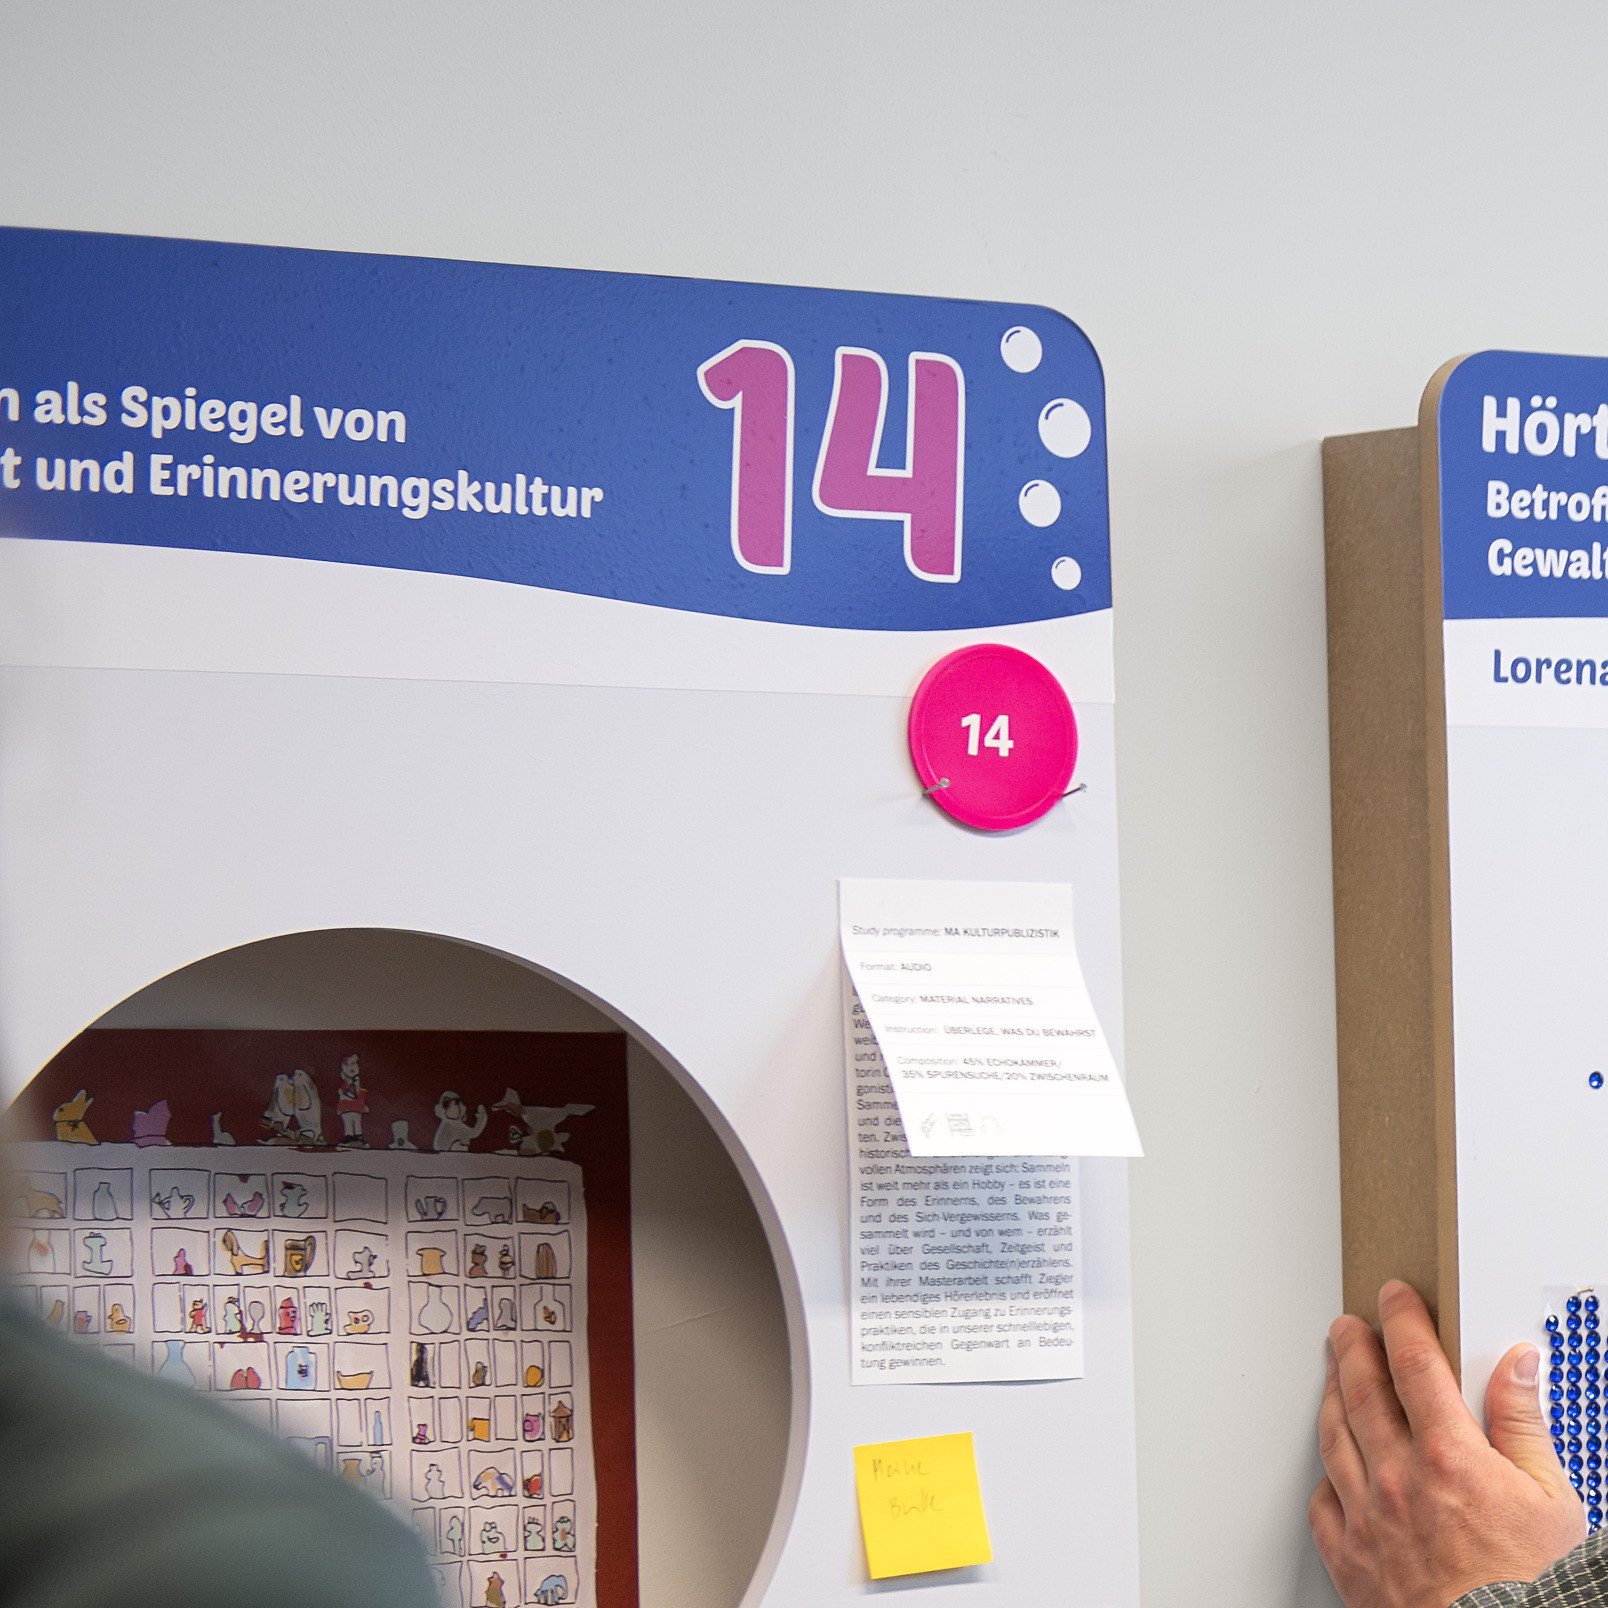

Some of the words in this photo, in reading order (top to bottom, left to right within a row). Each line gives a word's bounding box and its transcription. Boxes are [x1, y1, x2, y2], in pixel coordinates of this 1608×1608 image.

[34, 381, 107, 426] als
[119, 385, 304, 444] Spiegel
[314, 405, 406, 444] von
[697, 339, 966, 583] 14
[35, 451, 134, 495] und
[149, 452, 603, 520] Erinnerungskultur
[961, 713, 1014, 757] 14
[852, 925, 880, 937] Study
[882, 927, 942, 938] programme:
[944, 927, 960, 937] MA
[963, 928, 1060, 938] KULTURPUBLIZISTIK
[900, 963, 932, 972] AUDIO
[919, 995, 969, 1005] MATERIAL
[971, 996, 1034, 1006] NARRATIVES
[1001, 1026, 1025, 1036] WAS
[1026, 1027, 1041, 1037] DU
[859, 1164, 892, 1175] vollen
[894, 1163, 967, 1176] Atmosphären
[968, 1163, 994, 1176] zeigt
[1021, 1162, 1070, 1173] Sammeln
[902, 1180, 931, 1190] mehr
[933, 1179, 949, 1190] als
[952, 1179, 970, 1190] ein
[972, 1178, 1006, 1191] Hobby
[1018, 1180, 1031, 1189] es
[1033, 1178, 1046, 1189] ist
[1048, 1178, 1070, 1188] eine
[860, 1196, 888, 1207] Form
[896, 1196, 917, 1207] des
[987, 1195, 1007, 1206] des
[1014, 1194, 1071, 1206] Bewahrens
[860, 1212, 881, 1223] und
[889, 1212, 909, 1223] des
[1028, 1210, 1050, 1221] Was
[860, 1229, 909, 1240] sammelt
[951, 1228, 971, 1239] und
[975, 1229, 994, 1239] von
[998, 1229, 1023, 1238] wem
[1037, 1226, 1072, 1237] erzählt
[860, 1244, 880, 1256] viel
[888, 1244, 914, 1255] über
[1000, 1242, 1046, 1255] Zeitgeist
[1053, 1242, 1073, 1252] und
[860, 1260, 913, 1271] Praktiken
[919, 1260, 940, 1271] des
[860, 1277, 879, 1287] Mit
[886, 1276, 912, 1287] ihrer
[919, 1275, 988, 1287] Masterarbeit
[995, 1274, 1032, 1285] schafft
[1038, 1273, 1074, 1286] Ziegler
[860, 1293, 878, 1304] ein
[881, 1292, 942, 1305] lebendiges
[944, 1290, 1007, 1302] Hörerlebnis
[1010, 1289, 1030, 1300] und
[1033, 1288, 1074, 1299] eröffnet
[860, 1310, 891, 1320] einen
[893, 1308, 948, 1319] sensiblen
[950, 1307, 991, 1320] Zugang
[993, 1307, 1006, 1316] zu
[919, 1324, 936, 1335] die
[939, 1324, 949, 1334] in
[952, 1323, 994, 1334] unserer
[861, 1339, 943, 1352] konfliktreichen
[951, 1338, 1010, 1352] Gegenwart
[1017, 1338, 1031, 1347] an
[861, 1358, 886, 1370] tung
[888, 1356, 946, 1370] gewinnen.
